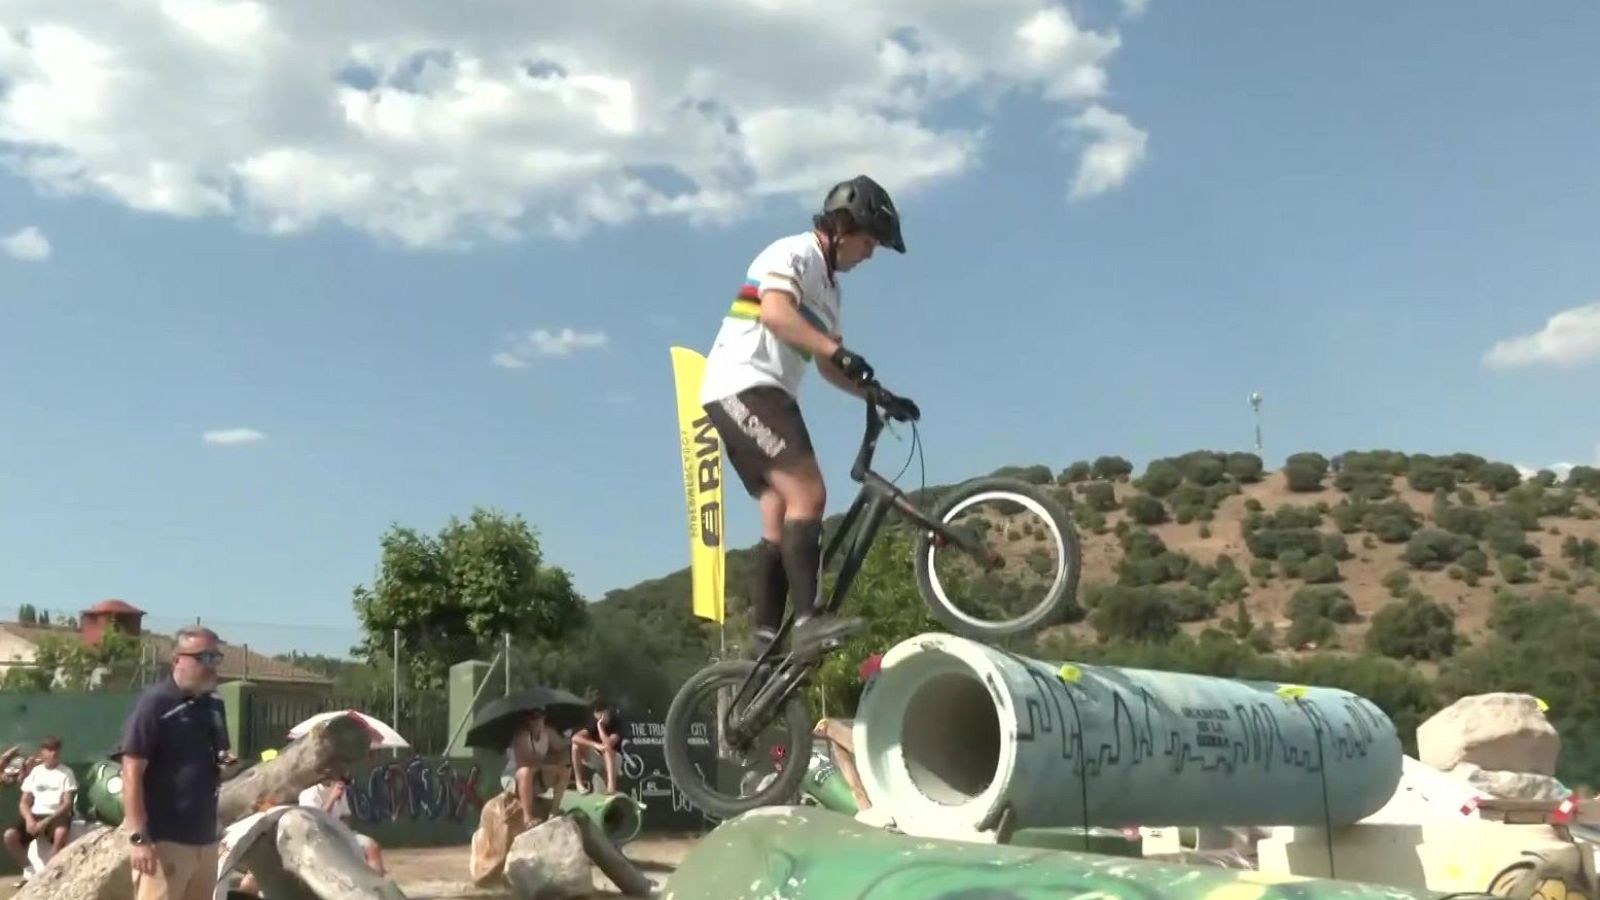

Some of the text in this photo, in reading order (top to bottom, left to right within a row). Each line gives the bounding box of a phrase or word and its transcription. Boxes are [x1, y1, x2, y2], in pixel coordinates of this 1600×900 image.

[630, 723, 706, 737] THE TRIA CITY
